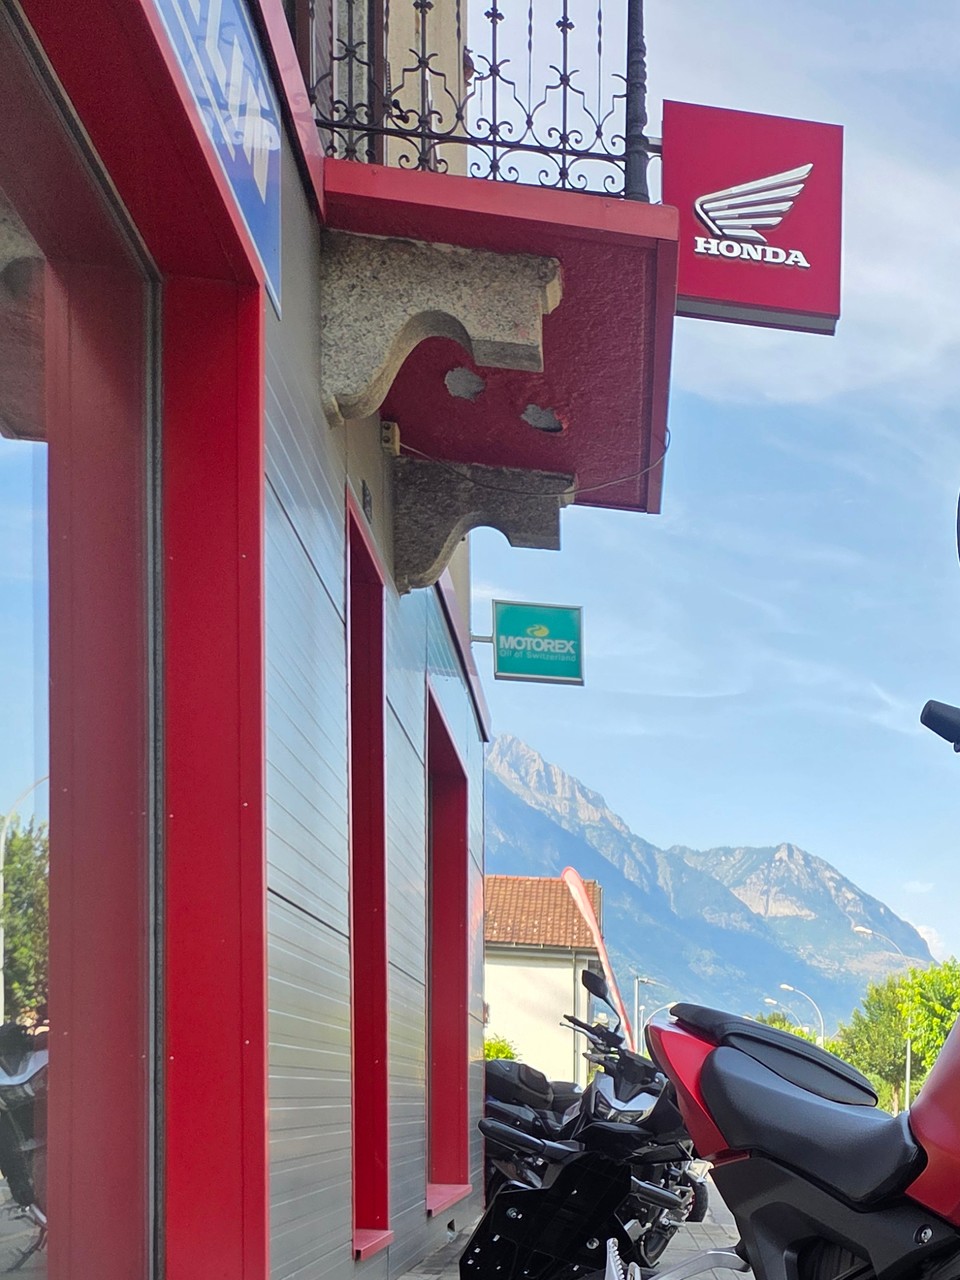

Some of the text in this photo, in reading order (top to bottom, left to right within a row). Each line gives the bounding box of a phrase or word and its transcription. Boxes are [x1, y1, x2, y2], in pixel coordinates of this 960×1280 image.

[694, 236, 811, 268] HONDA
[499, 635, 577, 655] MOTOREX
[526, 651, 577, 662] Switzerland
